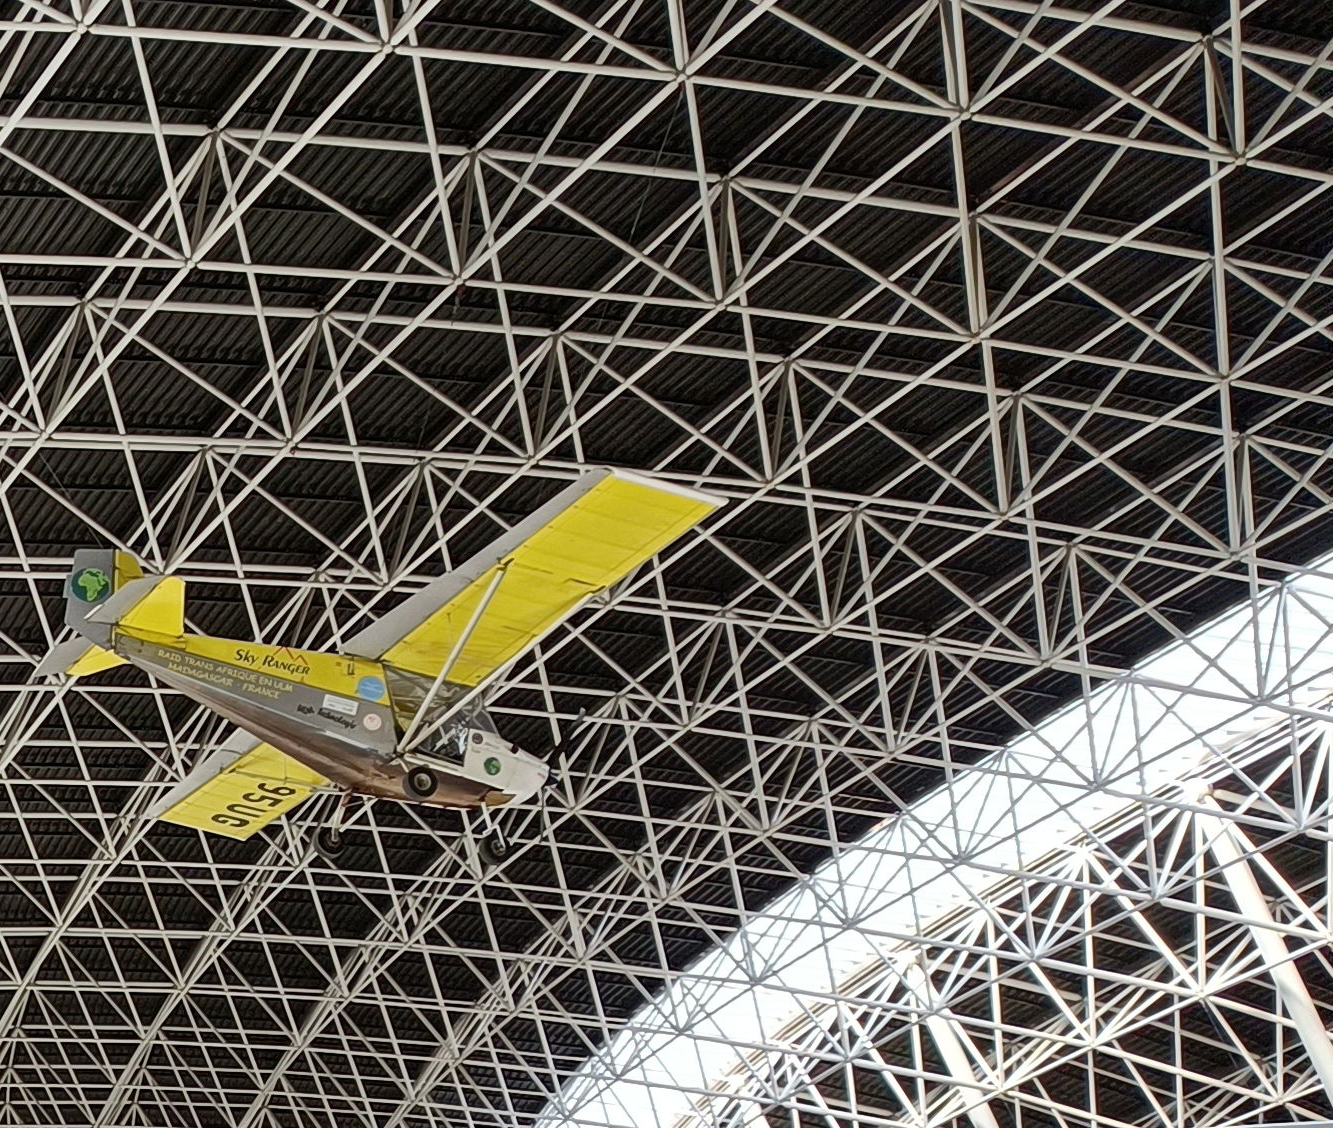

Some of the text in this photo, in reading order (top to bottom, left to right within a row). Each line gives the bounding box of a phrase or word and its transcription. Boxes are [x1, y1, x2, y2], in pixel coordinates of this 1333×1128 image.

[158, 649, 293, 693] RAID TRANS AFRIQUE EN ULM
[234, 648, 259, 666] Sky
[168, 662, 233, 688] MADAGASCAR
[241, 683, 282, 700] FRANCE
[211, 782, 297, 828] 95UG
